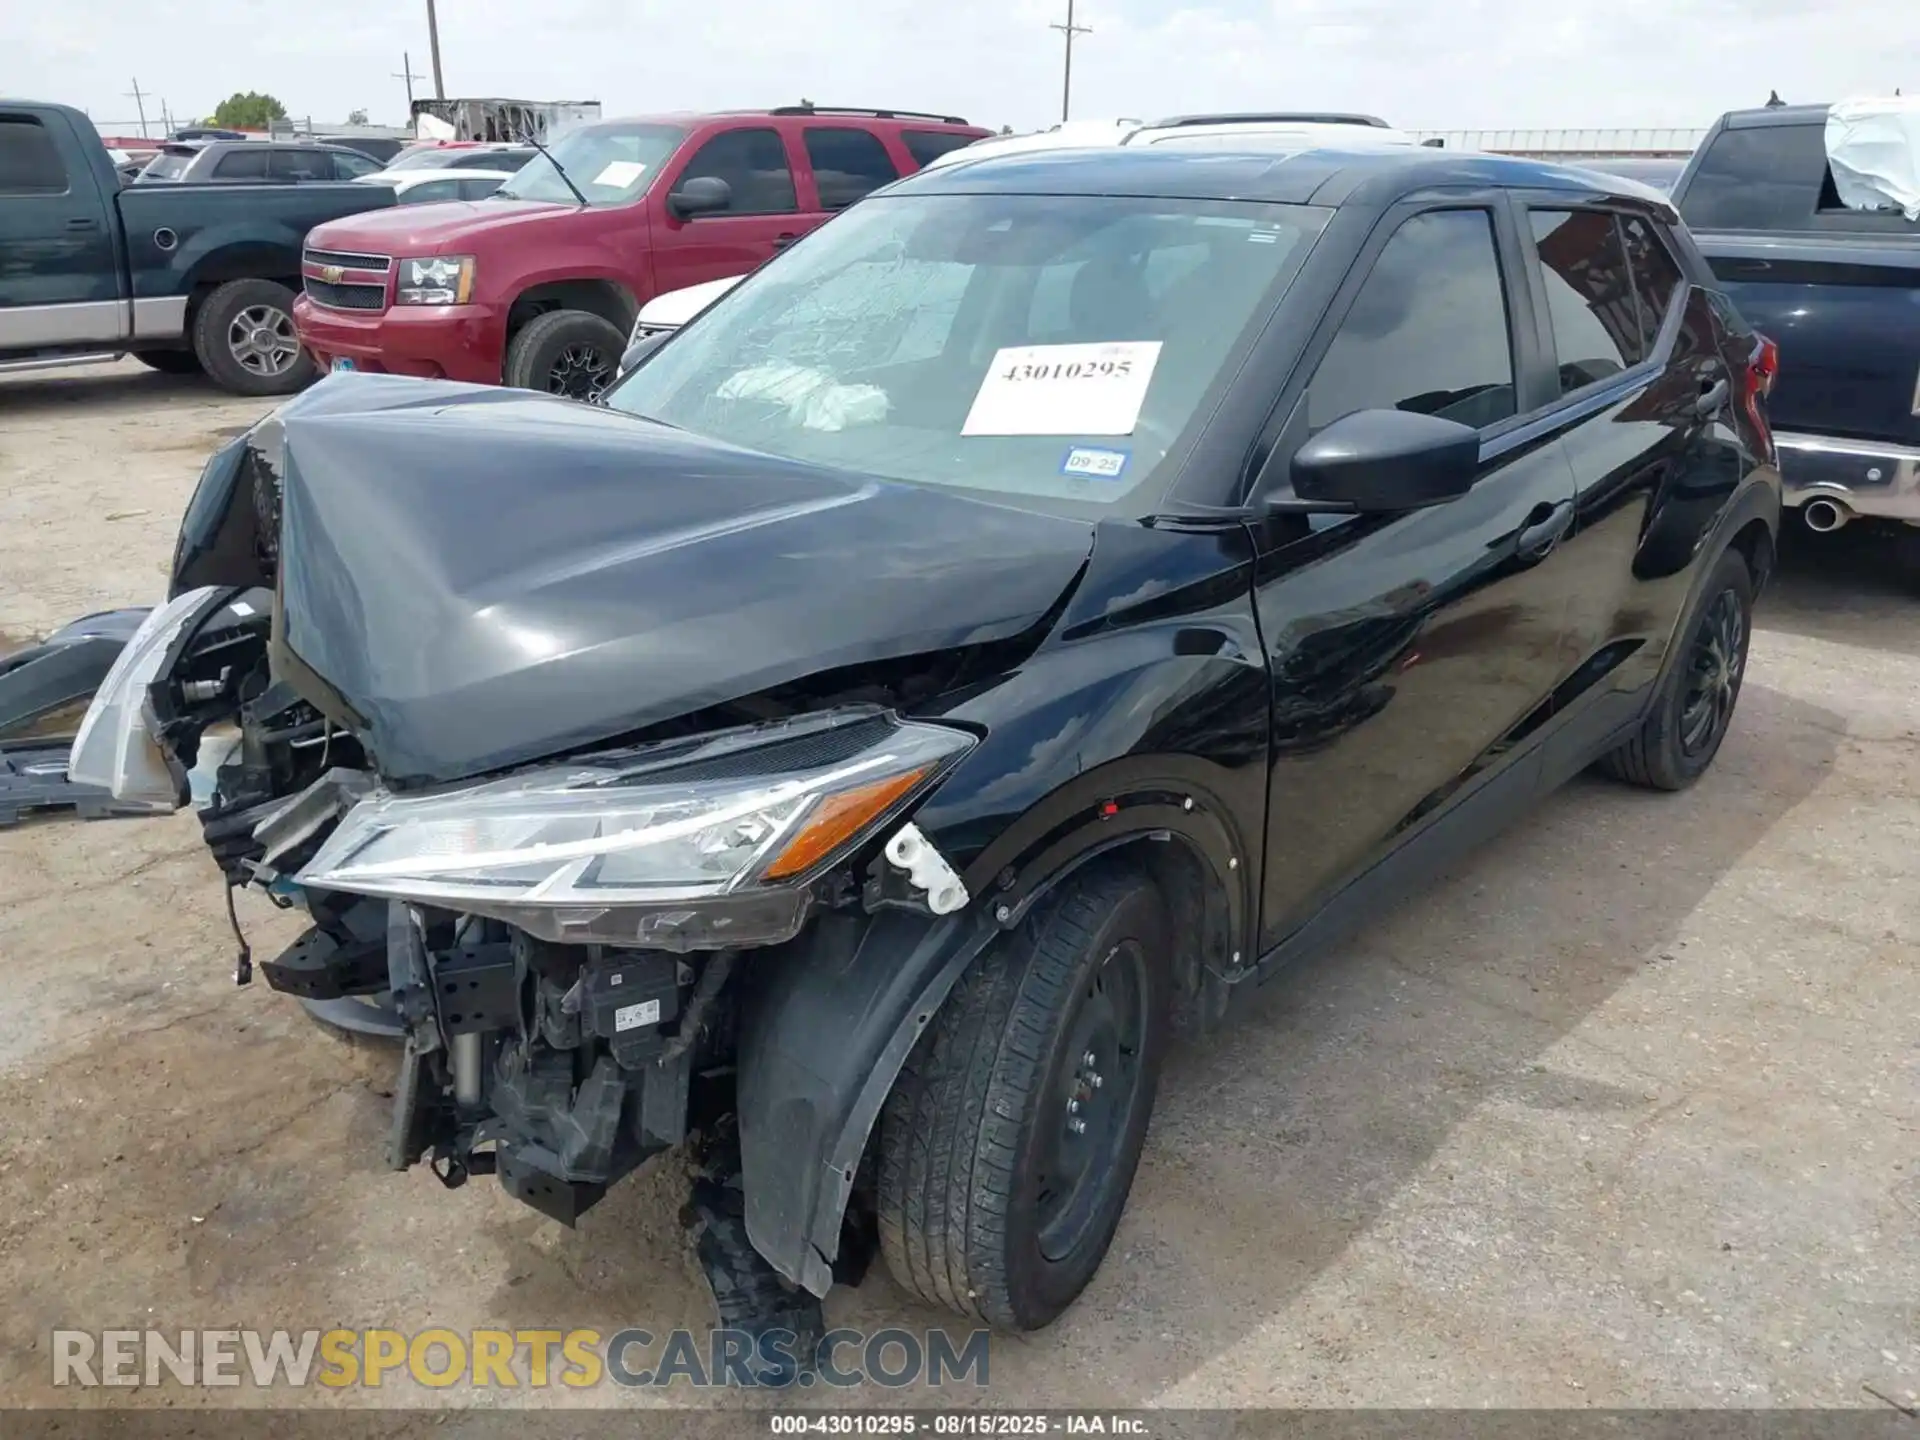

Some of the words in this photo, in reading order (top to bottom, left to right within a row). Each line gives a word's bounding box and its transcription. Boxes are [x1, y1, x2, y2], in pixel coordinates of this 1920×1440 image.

[1002, 361, 1132, 381] 43010295
[1070, 455, 1091, 468] 09
[1097, 457, 1118, 470] 25
